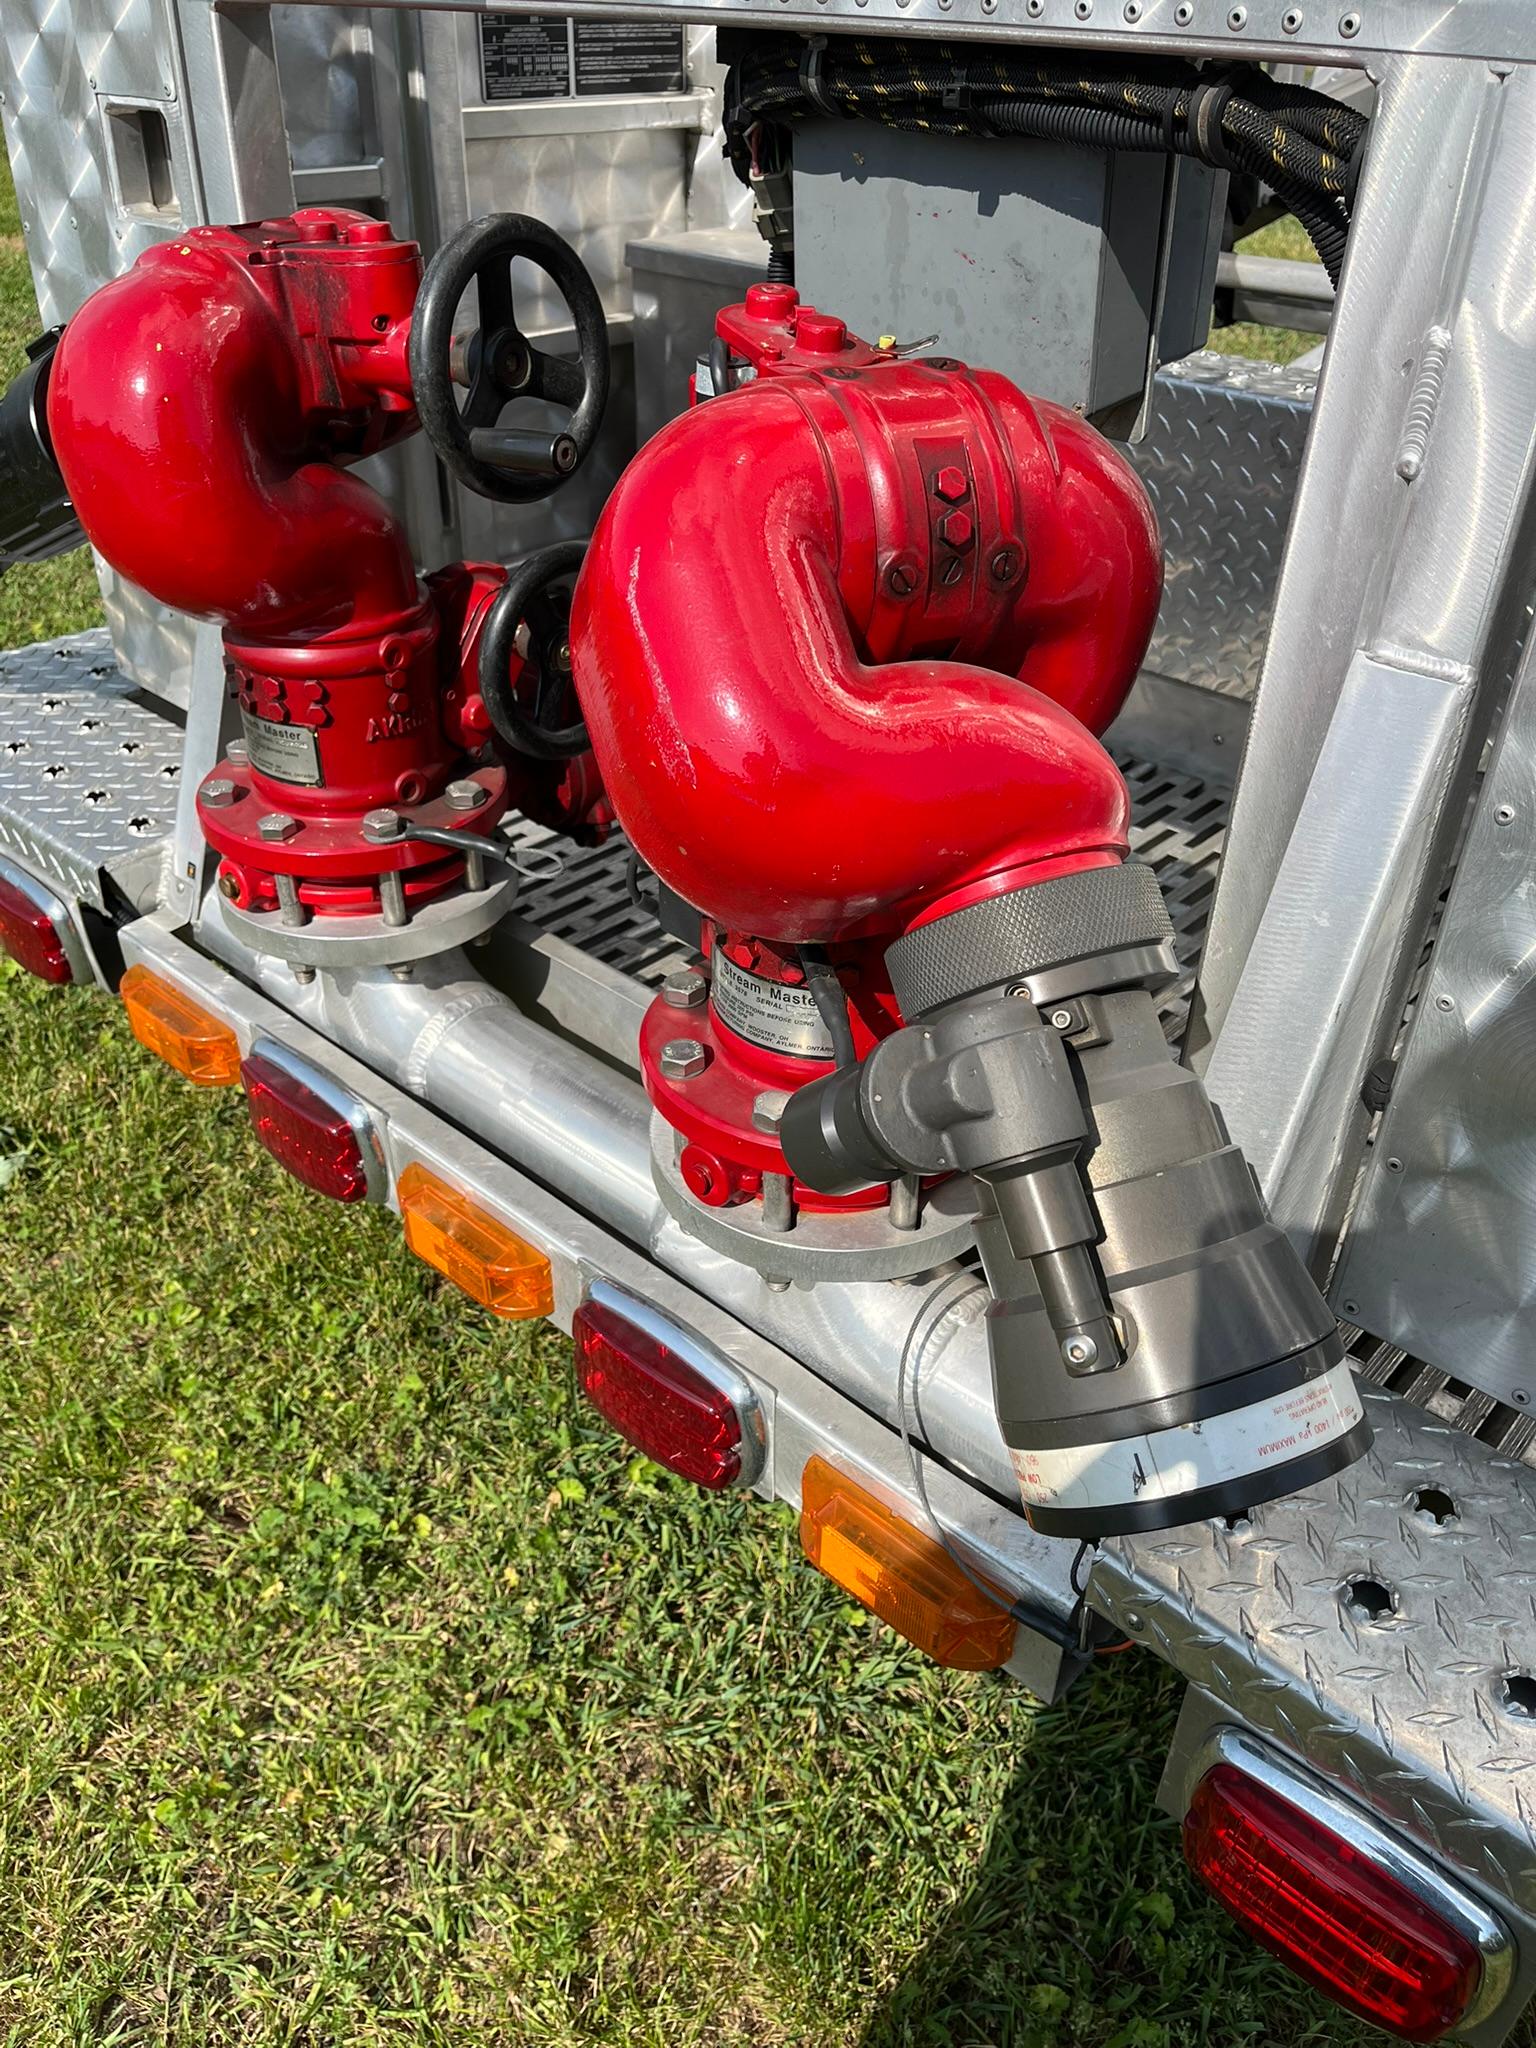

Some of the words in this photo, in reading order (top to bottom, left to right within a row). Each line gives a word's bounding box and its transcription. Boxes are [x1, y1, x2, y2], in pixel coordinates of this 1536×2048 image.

[263, 724, 302, 741] Master
[723, 962, 761, 994] Stream
[770, 988, 817, 1007] Maste
[756, 997, 783, 1010] SERIAL
[766, 1012, 792, 1025] BEFORE
[794, 1019, 815, 1028] USING
[746, 1028, 775, 1045] COMPANY,
[806, 1044, 836, 1054] ONTARIO
[1313, 1419, 1331, 1434] 1400
[1298, 1430, 1313, 1441] kPa
[1257, 1435, 1297, 1457] MAXIMUM
